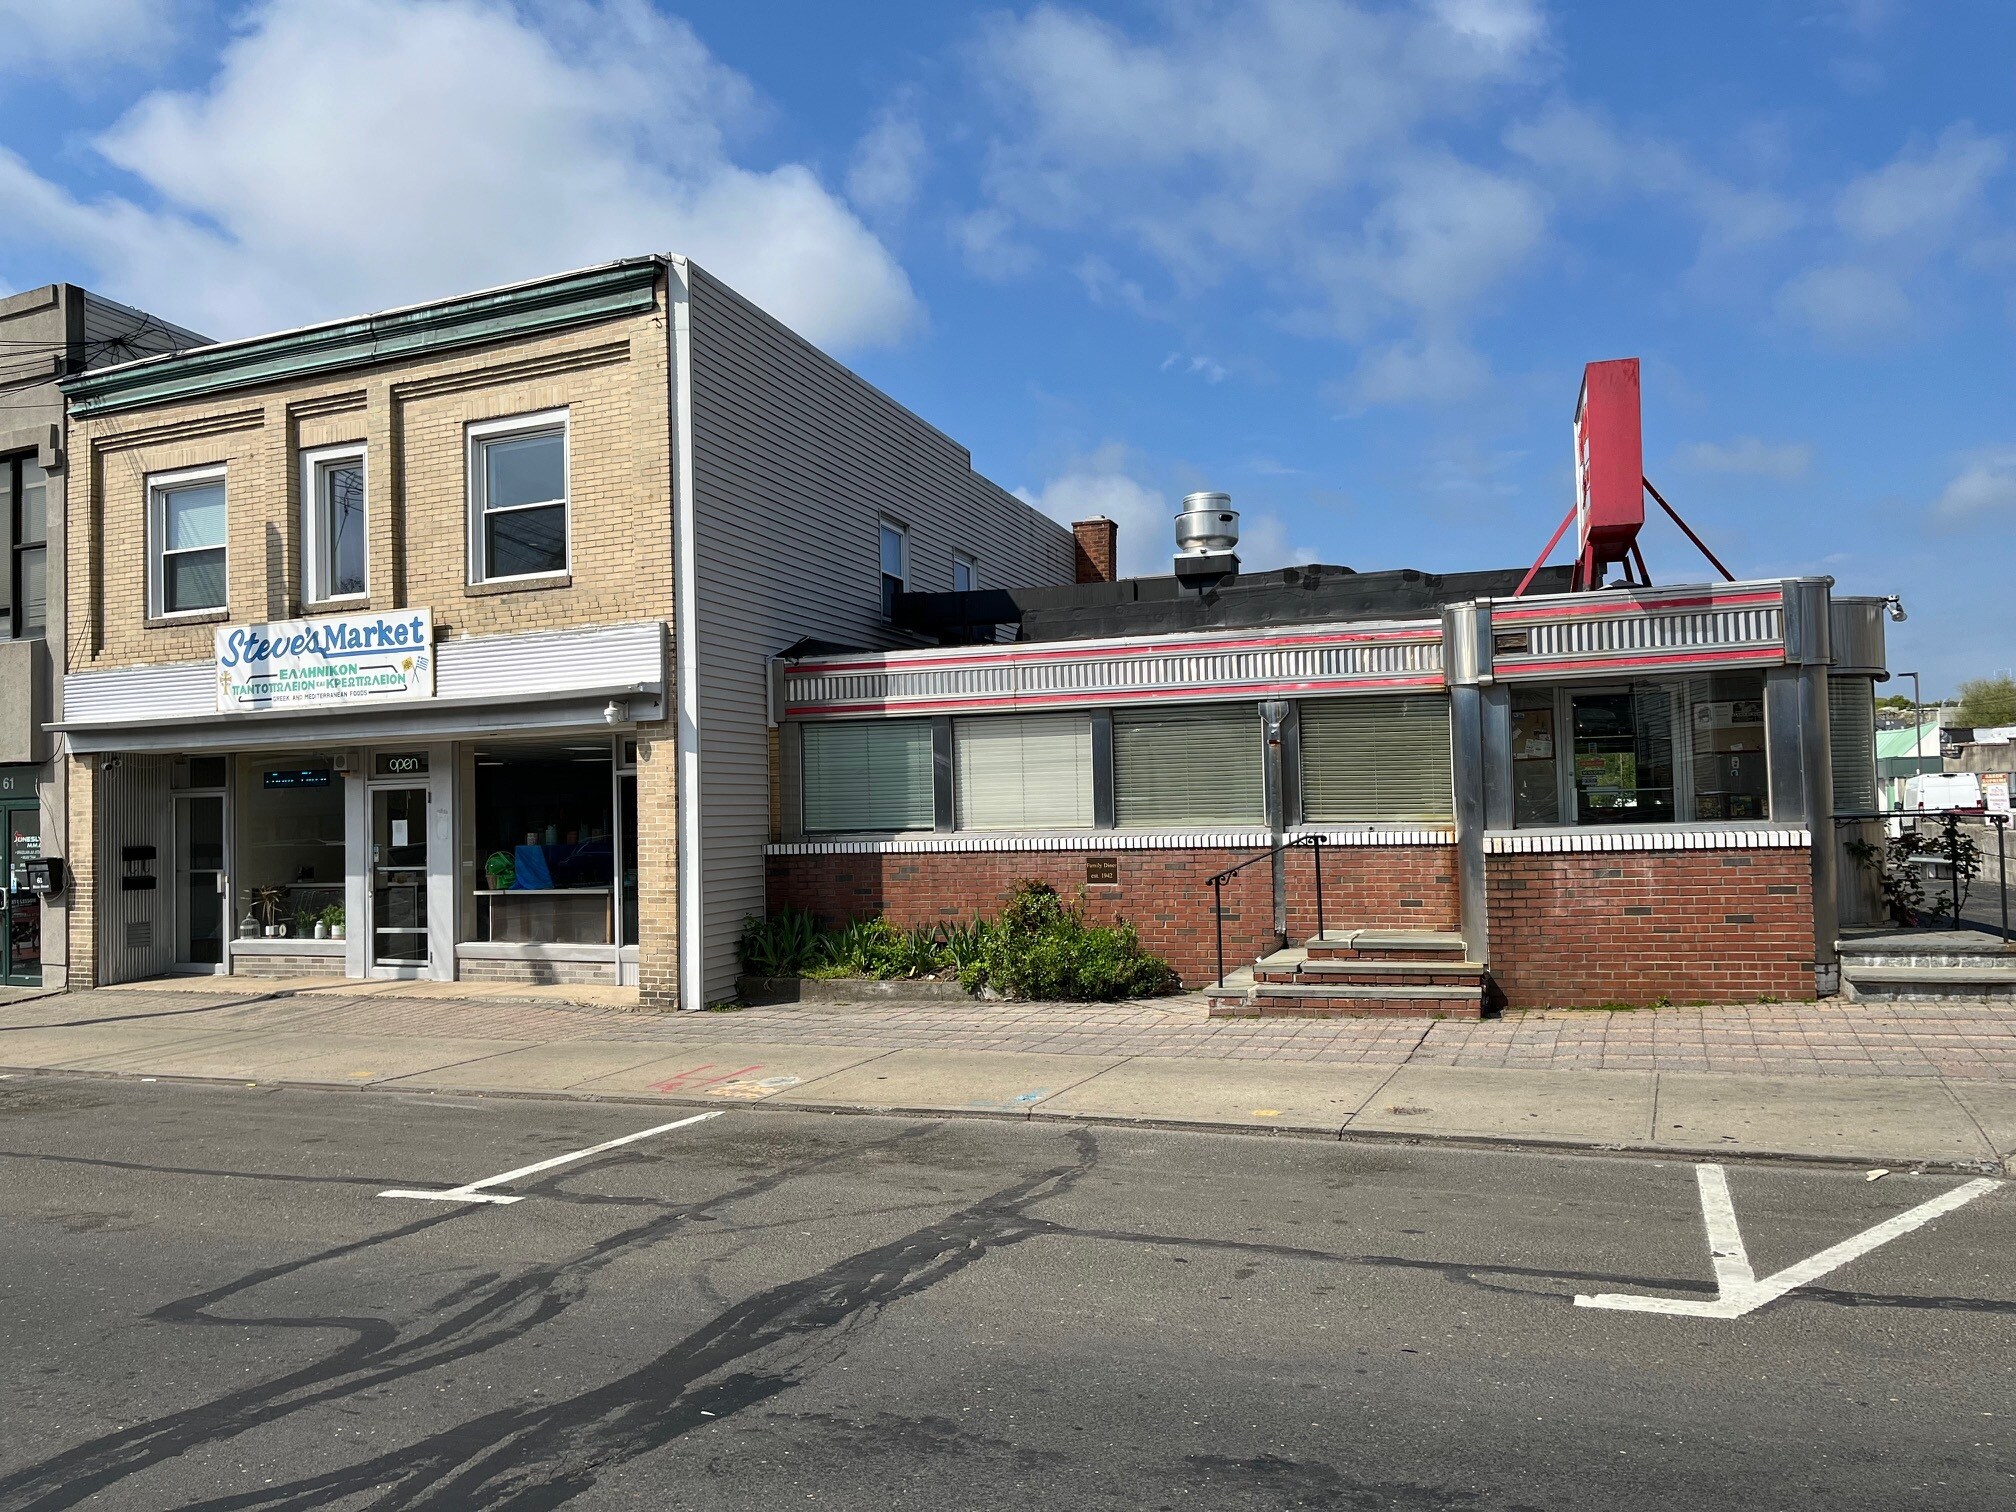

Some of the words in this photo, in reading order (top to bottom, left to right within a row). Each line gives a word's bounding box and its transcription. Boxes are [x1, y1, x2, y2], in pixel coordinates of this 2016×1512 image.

[221, 627, 321, 668] Steve's
[323, 616, 425, 650] Market
[279, 663, 358, 680] ΕΛΛΗΝΙΚΟΝ
[304, 691, 348, 701] MEDITERRANEAN
[349, 689, 368, 697] FOODS
[390, 758, 418, 773] open
[3, 777, 14, 790] 61
